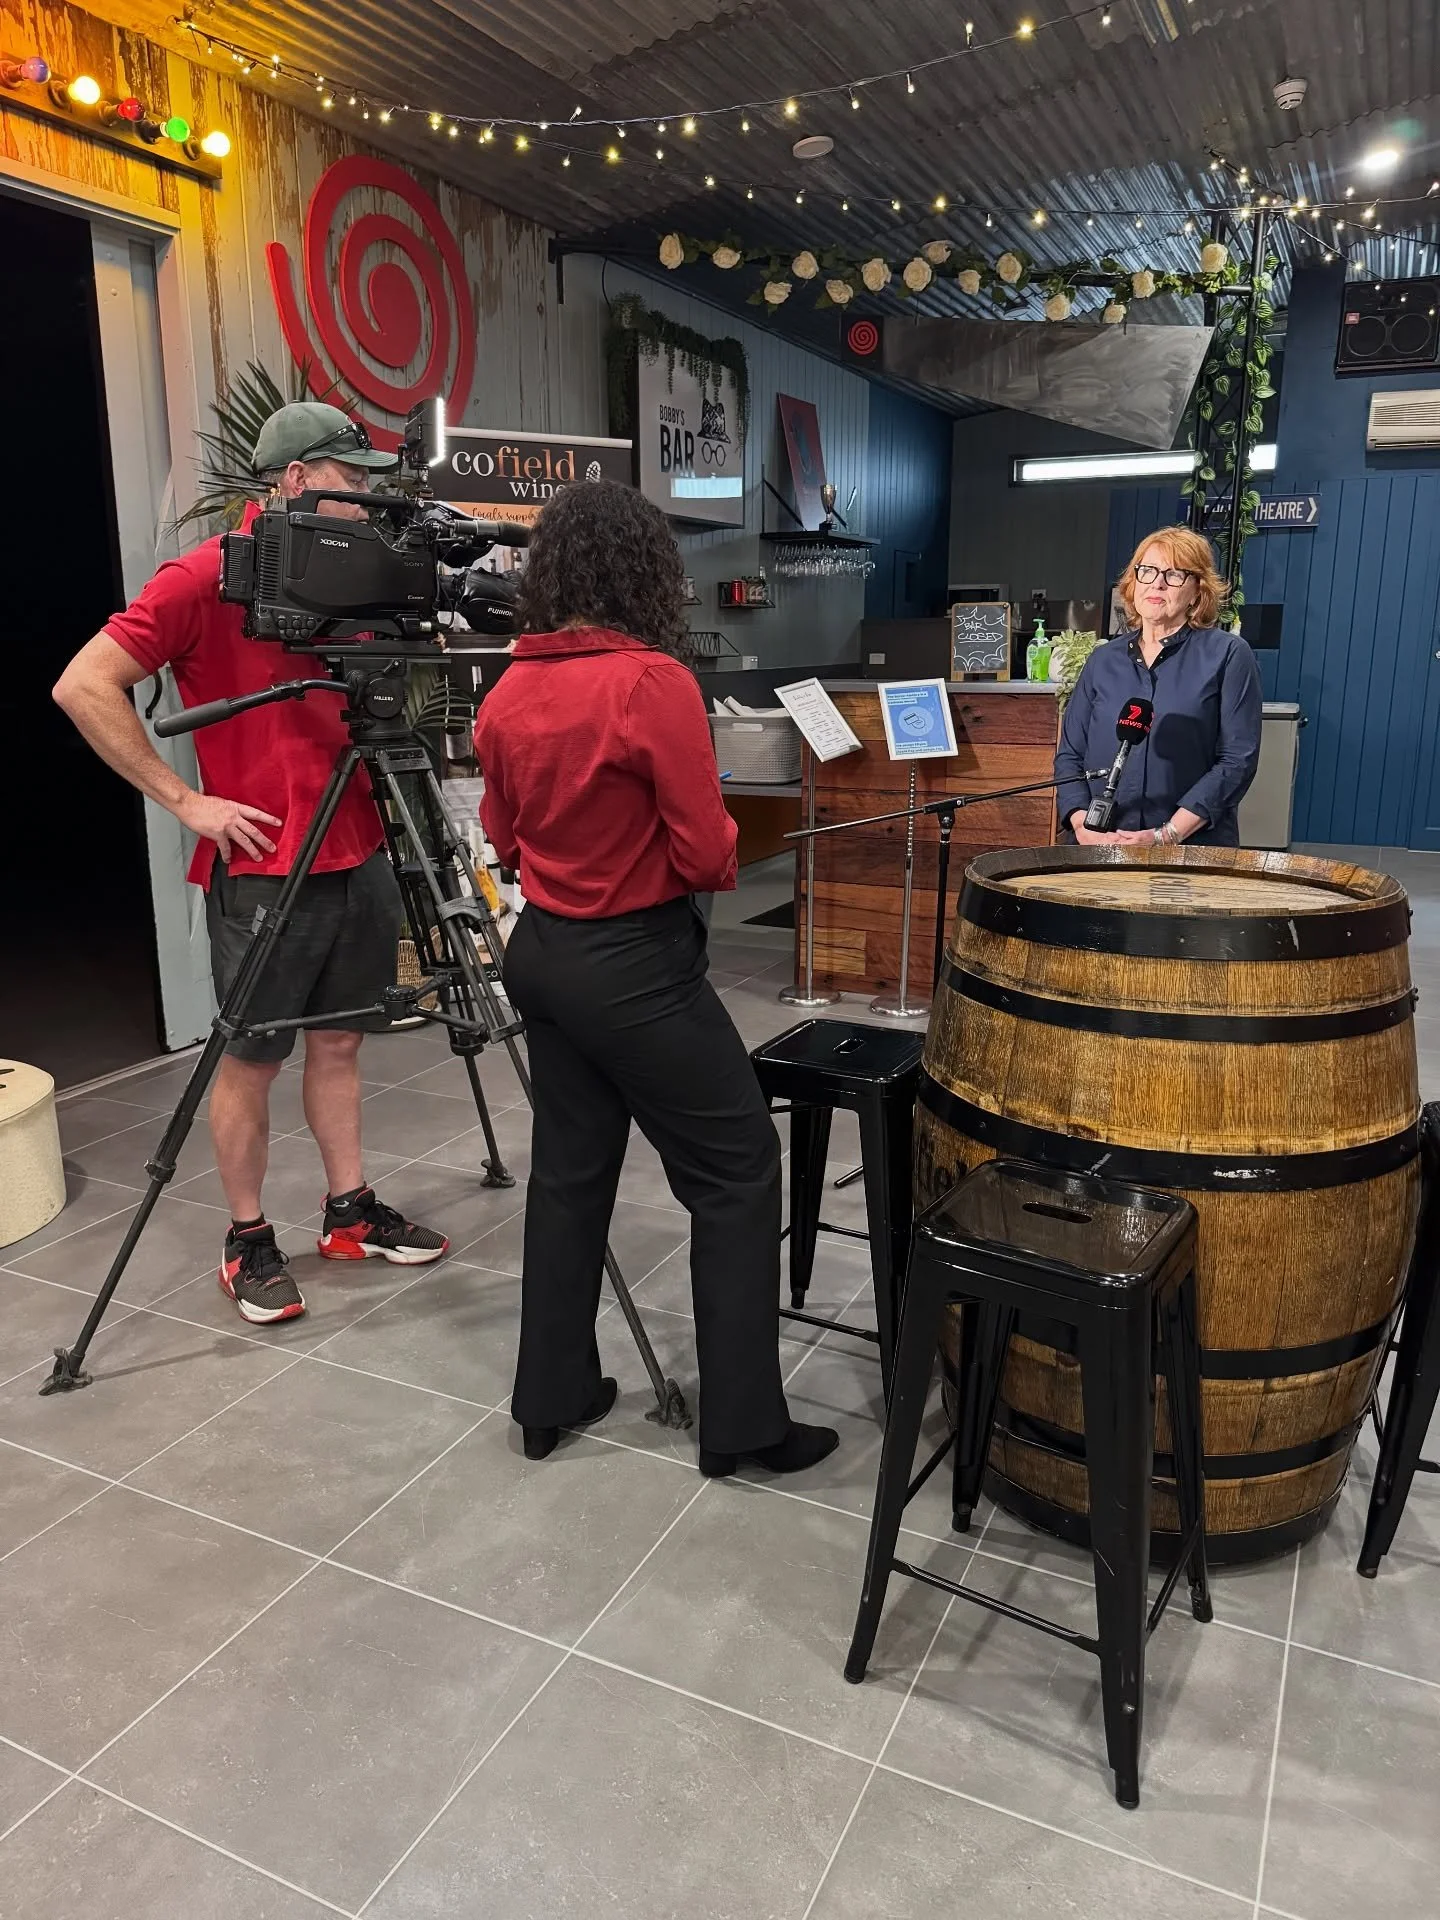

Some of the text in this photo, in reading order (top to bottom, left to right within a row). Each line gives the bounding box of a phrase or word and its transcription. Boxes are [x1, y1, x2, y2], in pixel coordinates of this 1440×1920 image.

[659, 404, 685, 426] BOBBY'S
[660, 424, 694, 473] BAR
[451, 445, 579, 481] cofield
[1254, 501, 1305, 521] THEATRE
[320, 538, 349, 549] XDCAM
[963, 621, 987, 632] BAR
[957, 633, 1003, 643] CLOSED
[1127, 704, 1142, 720] 7
[1118, 718, 1143, 729] NEWS
